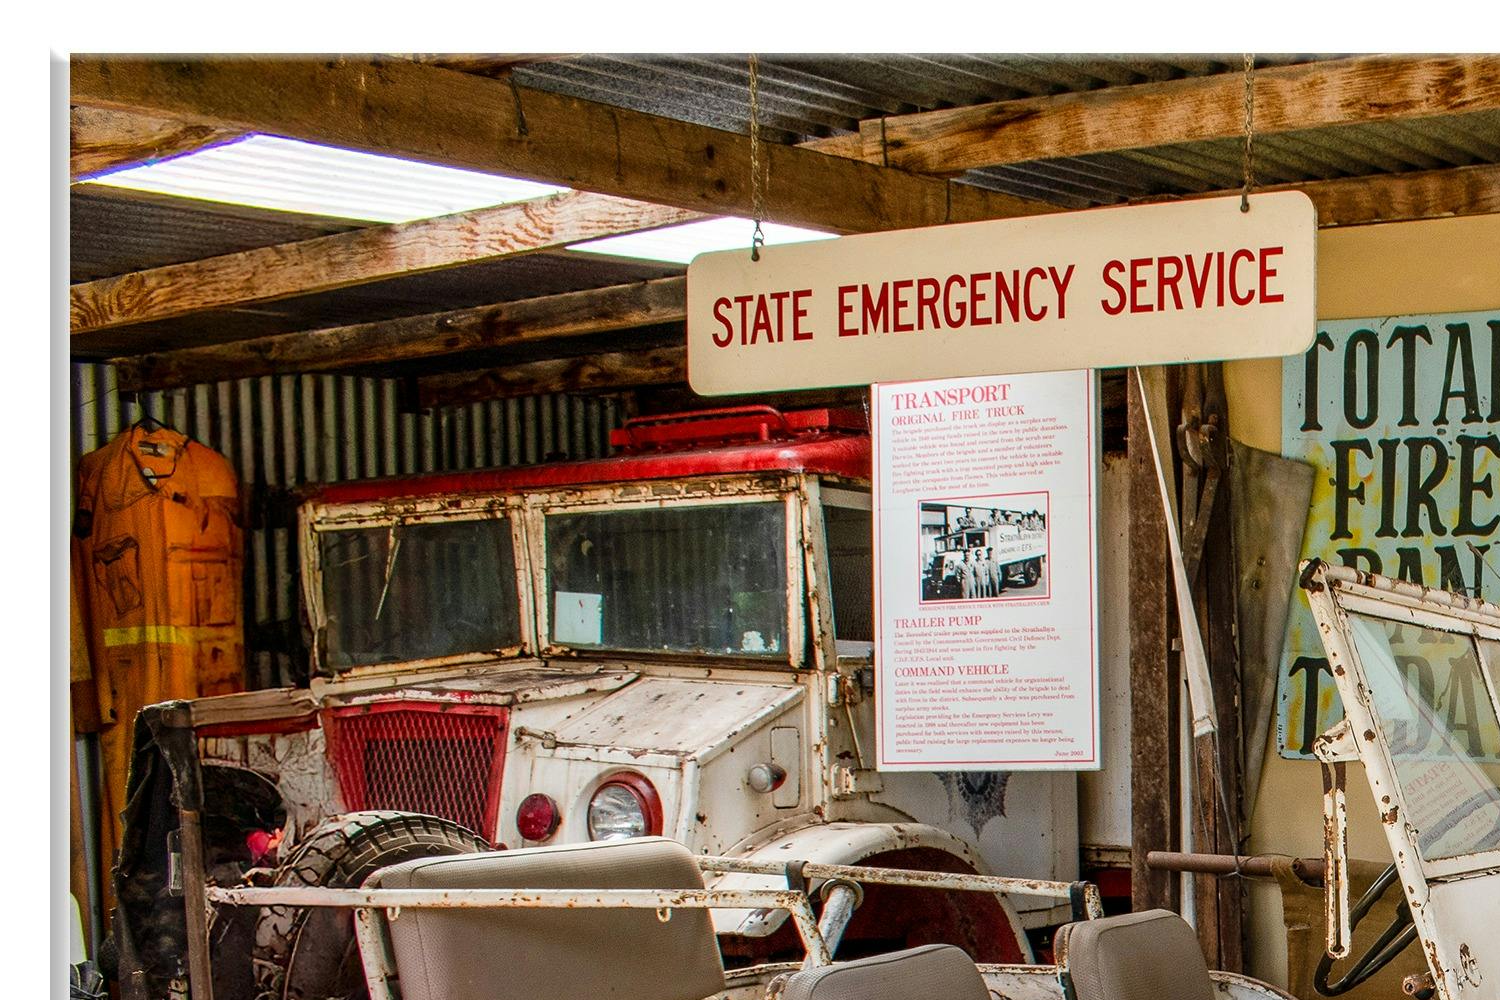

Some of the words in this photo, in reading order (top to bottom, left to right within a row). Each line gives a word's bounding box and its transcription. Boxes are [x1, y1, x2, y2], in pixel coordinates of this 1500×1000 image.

[712, 289, 813, 348] STATE
[838, 264, 1075, 338] EMERGENCY
[1101, 246, 1284, 316] SERVICE
[891, 383, 1011, 411] TRANSPORT
[892, 413, 945, 426] ORIGINAL
[952, 410, 979, 421] FIRE
[986, 405, 1024, 417] TRUCK
[894, 618, 944, 629] TRAILER
[948, 616, 982, 626] PUMP
[895, 666, 954, 678] COMMAND
[958, 664, 1009, 676] VEHICLE
